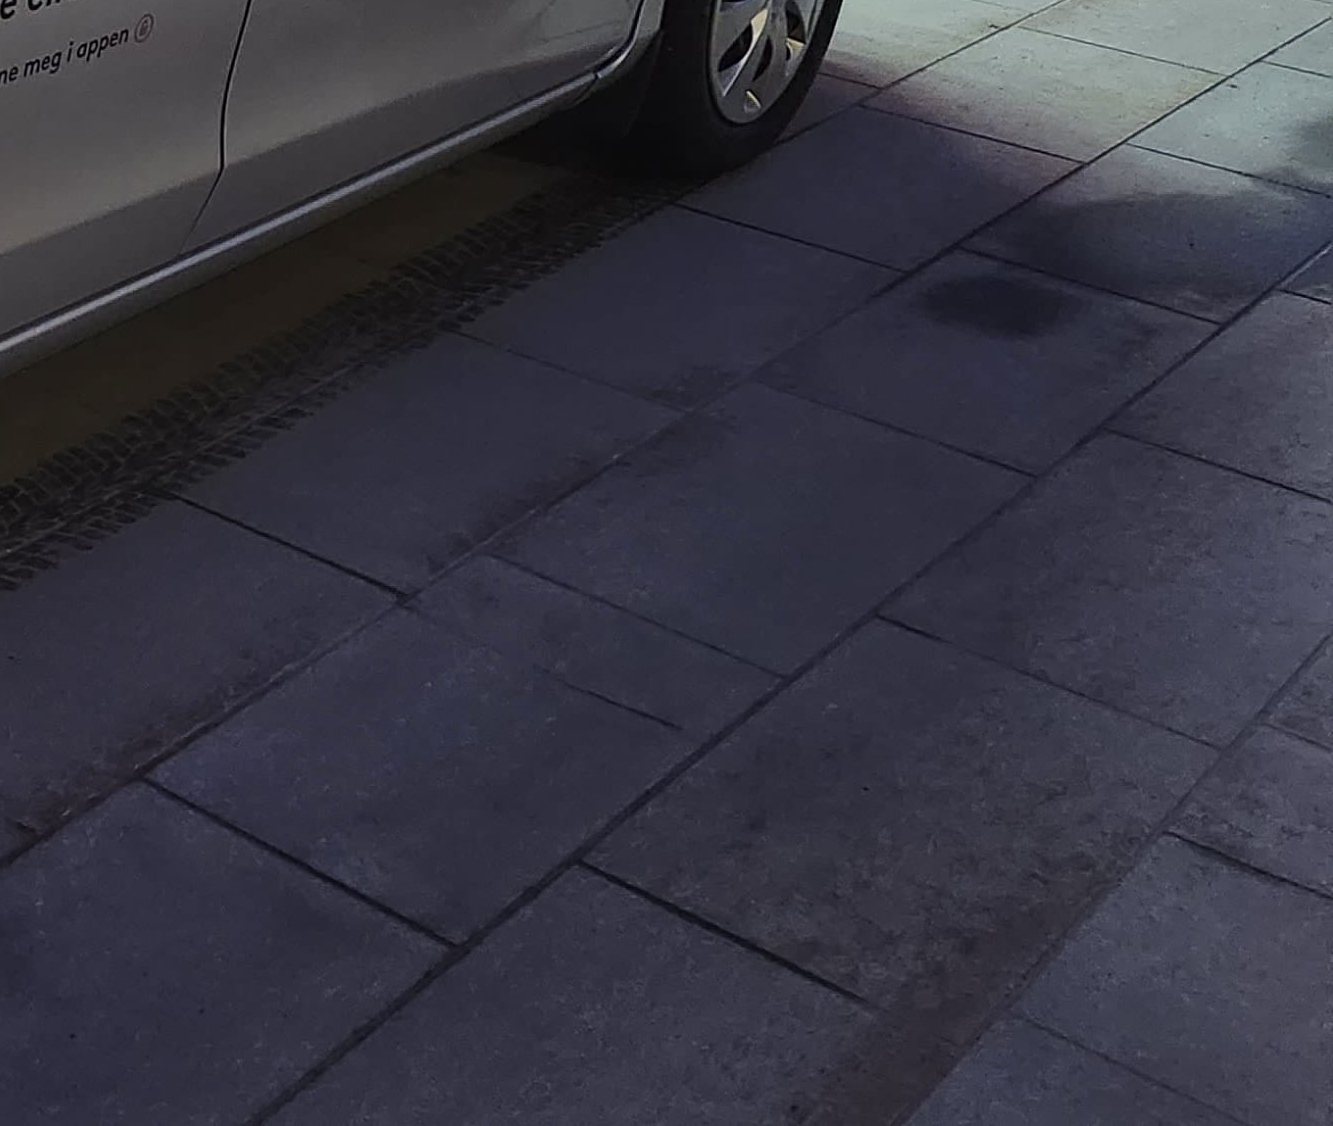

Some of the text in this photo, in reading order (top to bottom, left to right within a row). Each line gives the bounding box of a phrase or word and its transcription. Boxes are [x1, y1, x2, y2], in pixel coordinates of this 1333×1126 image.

[23, 51, 63, 79] meg
[66, 41, 74, 63] i
[76, 26, 130, 63] appen
